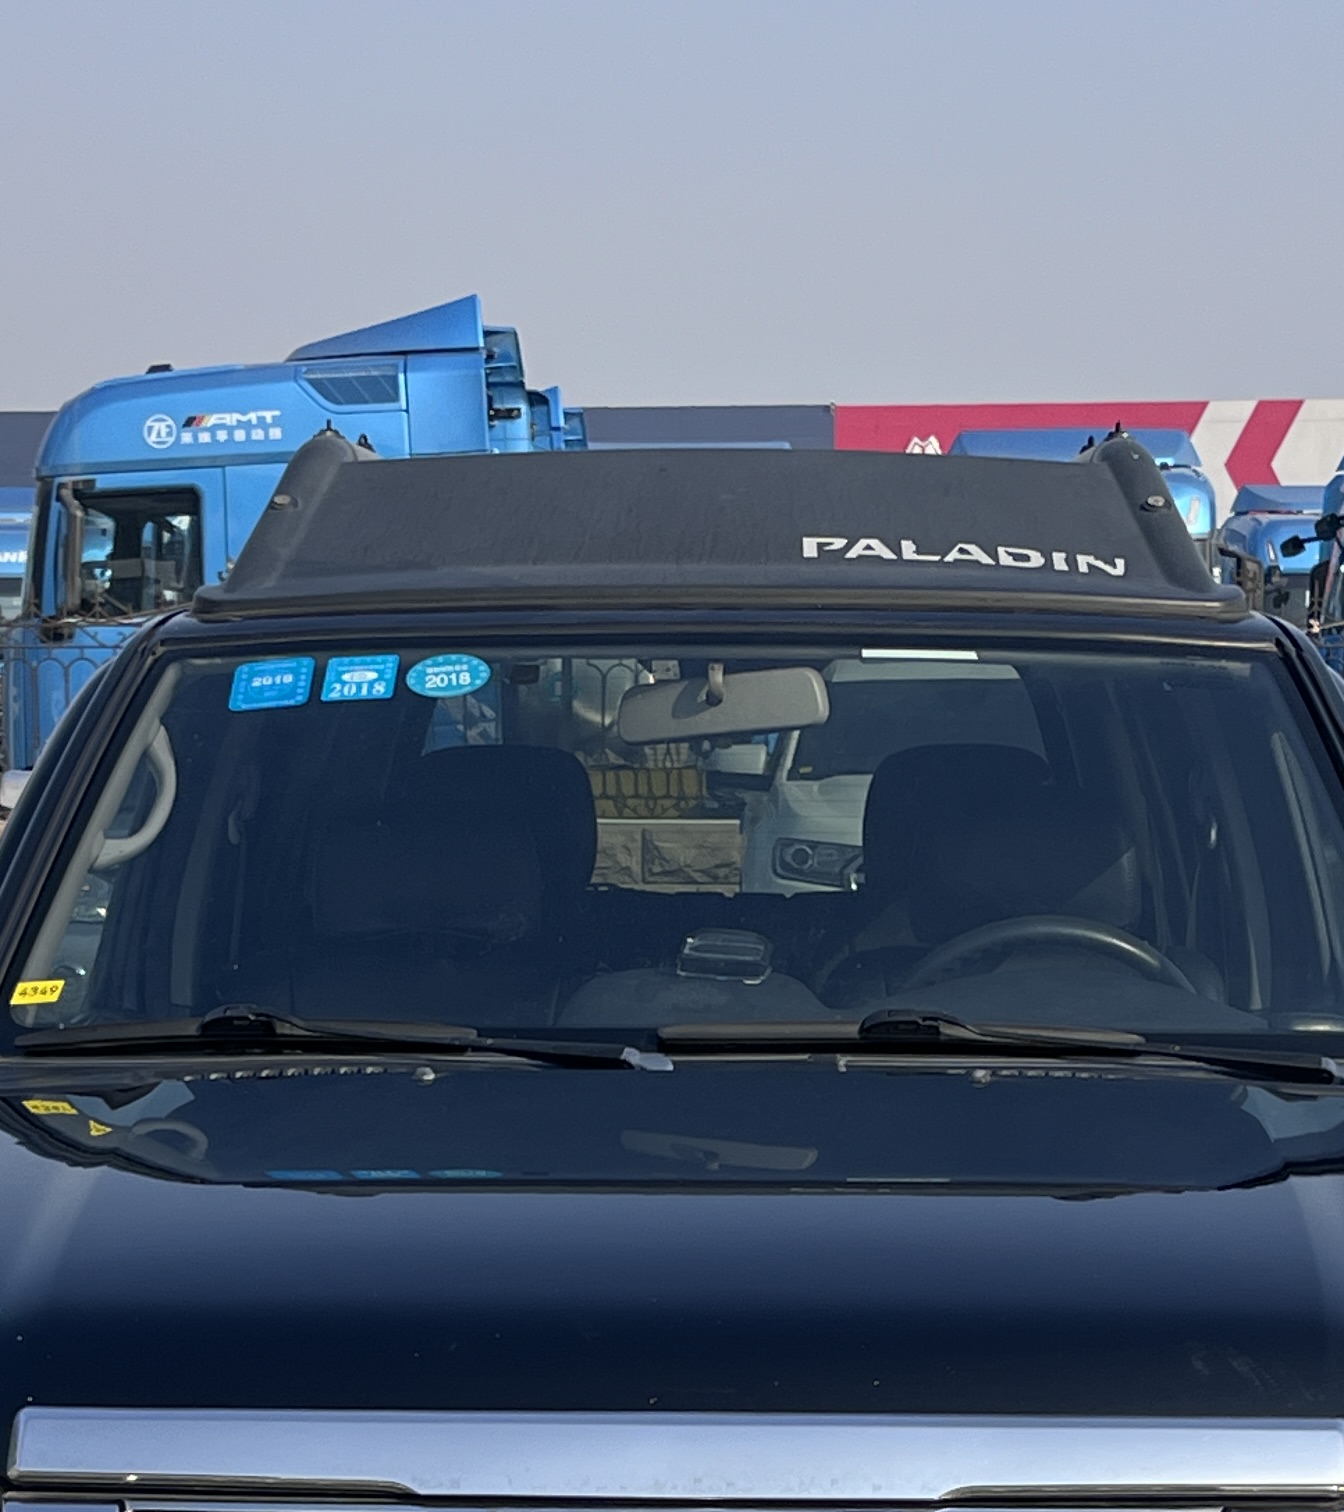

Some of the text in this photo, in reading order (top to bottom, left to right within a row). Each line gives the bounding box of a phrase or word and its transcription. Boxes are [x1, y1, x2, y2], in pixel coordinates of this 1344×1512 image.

[206, 409, 282, 428] AMT
[801, 536, 1126, 577] PALADIN
[251, 673, 295, 688] 2018
[424, 671, 472, 689] 2018
[327, 681, 387, 699] 2018
